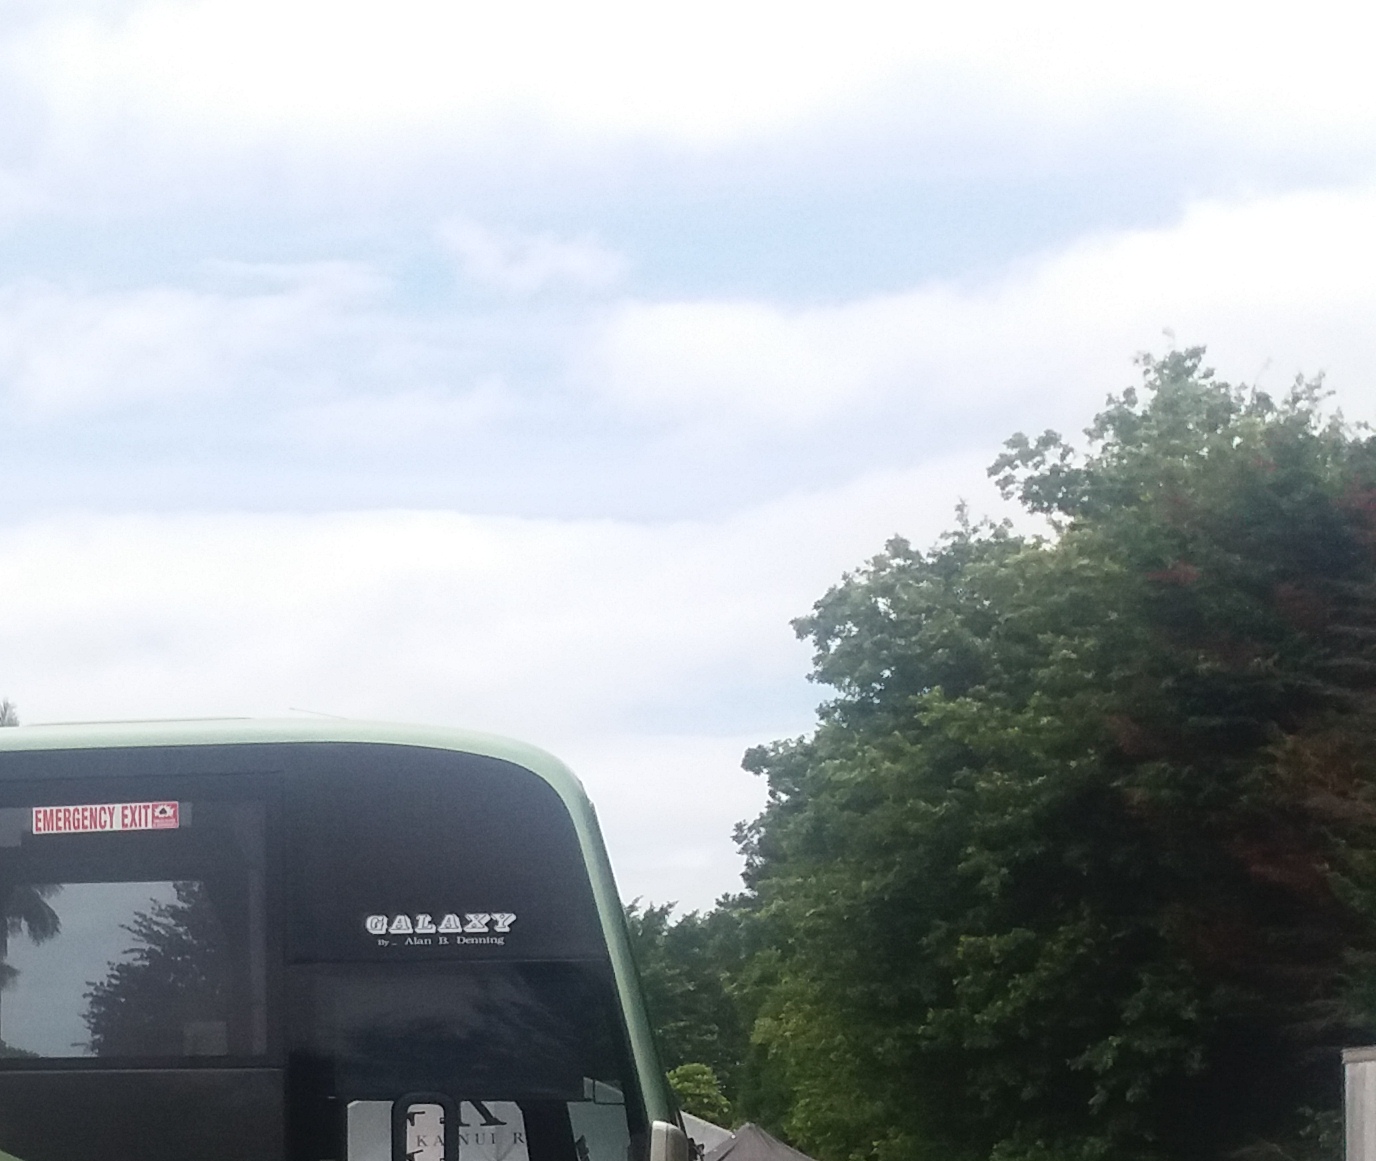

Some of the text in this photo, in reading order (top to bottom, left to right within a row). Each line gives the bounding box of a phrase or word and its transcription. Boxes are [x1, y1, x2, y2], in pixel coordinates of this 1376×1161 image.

[34, 803, 150, 832] EMERGENCY EXIT
[366, 913, 517, 935] GALAXY
[404, 936, 432, 946] Alan
[456, 936, 506, 946] Denning
[416, 1132, 496, 1148] KANUI
